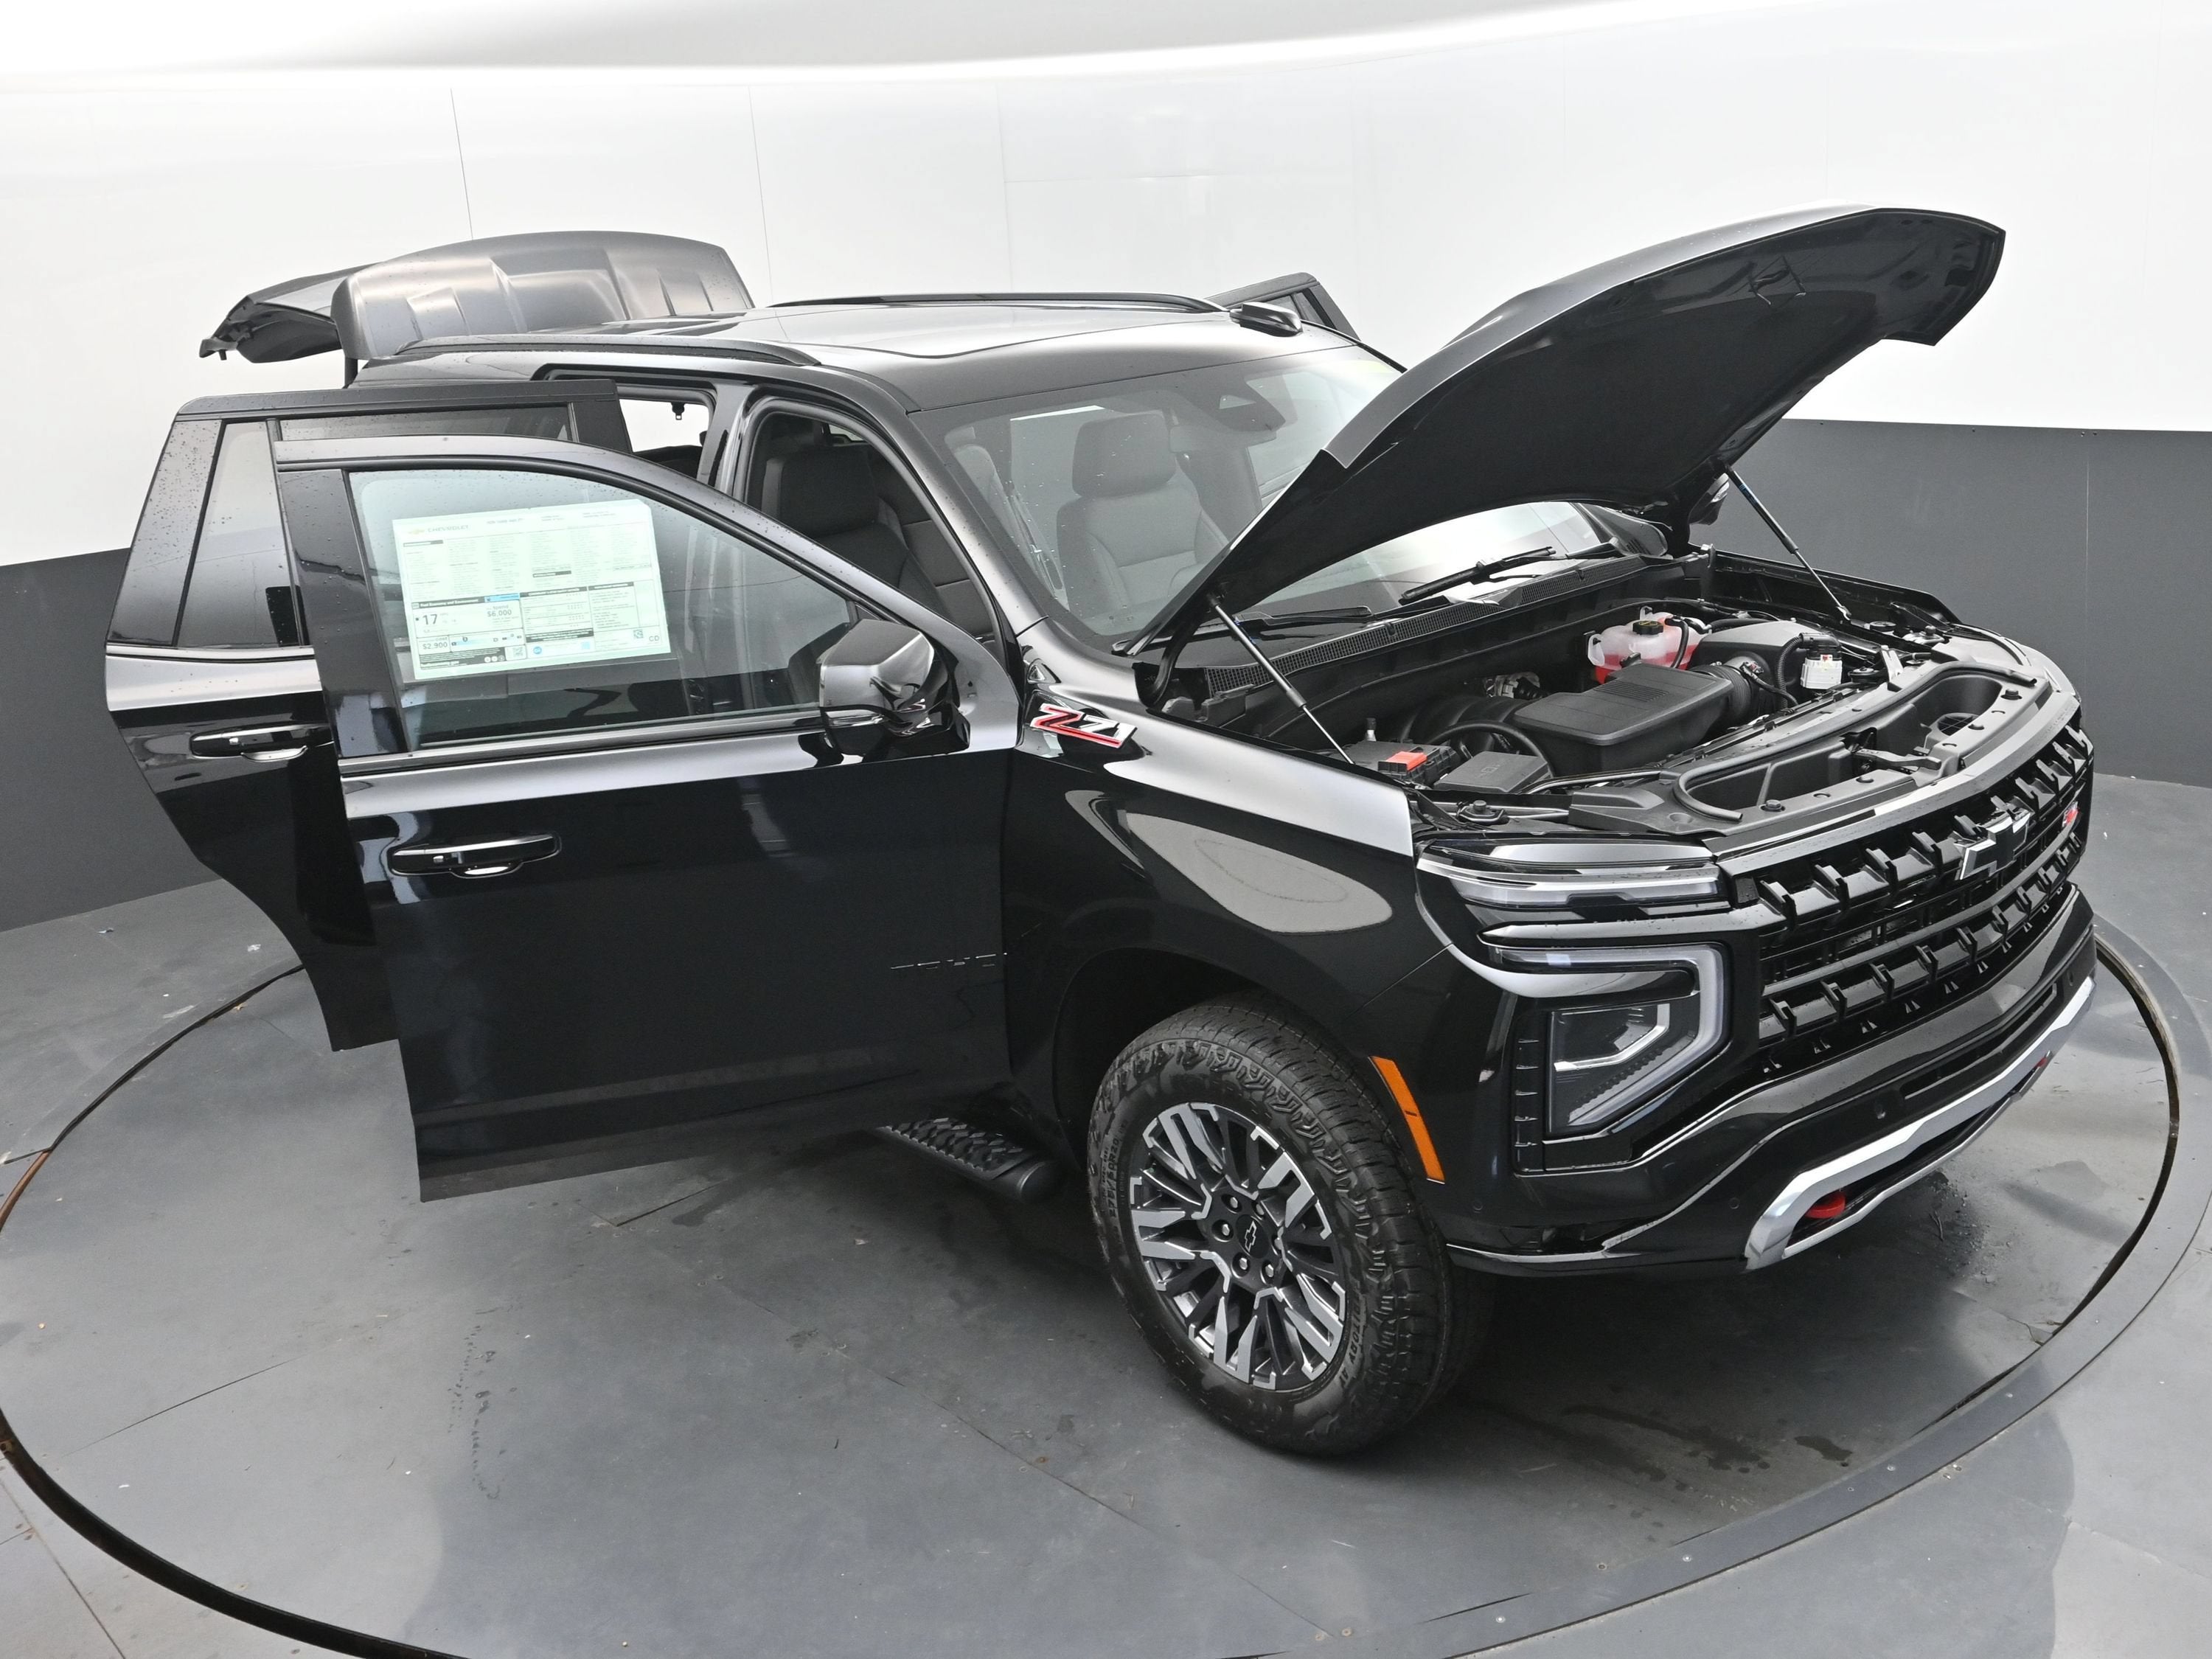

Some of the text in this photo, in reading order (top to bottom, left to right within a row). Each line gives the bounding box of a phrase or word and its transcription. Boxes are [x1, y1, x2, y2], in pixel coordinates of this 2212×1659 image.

[427, 524, 469, 533] CHEVROLET
[487, 609, 512, 617] $6,000
[422, 613, 438, 625] 17
[422, 641, 448, 650] $2,900
[1030, 703, 1138, 748] Z71
